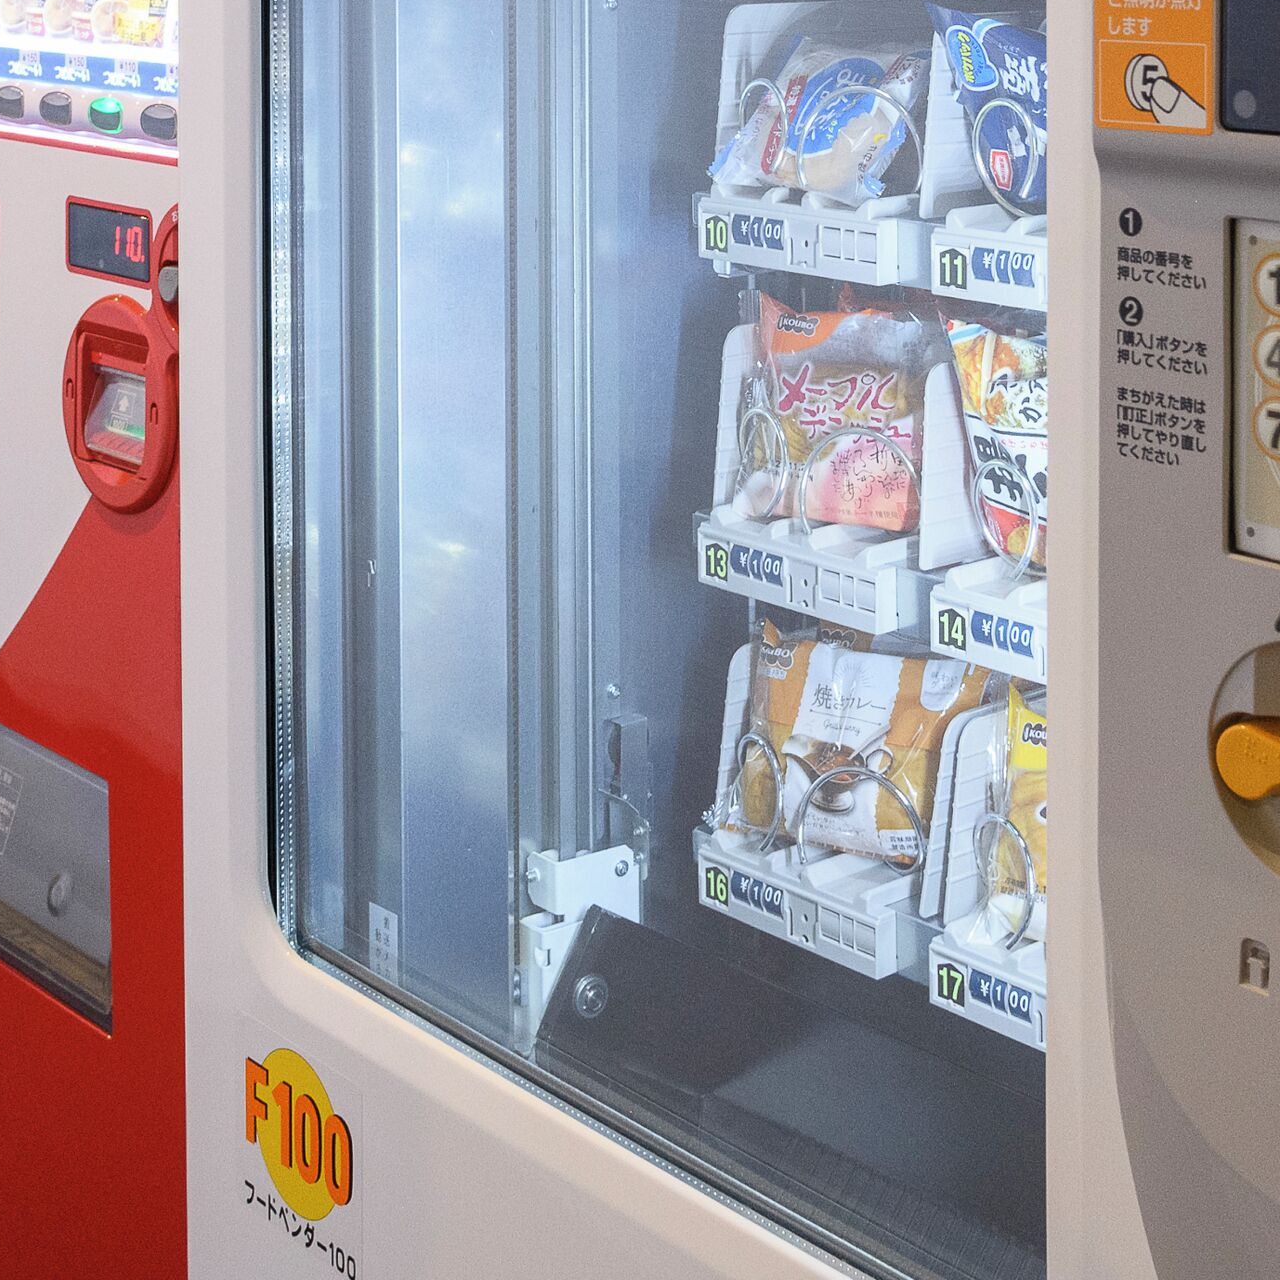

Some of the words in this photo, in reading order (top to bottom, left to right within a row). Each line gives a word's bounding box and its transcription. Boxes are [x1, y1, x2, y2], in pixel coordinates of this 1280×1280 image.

[1108, 16, 1152, 36] します
[706, 220, 727, 249] 10
[941, 253, 966, 285] 11
[1117, 247, 1193, 270] 商品の番号を
[1117, 266, 1207, 289] 押してください
[781, 316, 816, 331] KOUBO
[1117, 329, 1207, 357] 「購入」ボタンを
[1117, 349, 1208, 375] 押してください
[778, 364, 896, 412] メープル
[1117, 387, 1206, 414] まちがえた時は
[1117, 405, 1206, 434] 「訂正」ボタンを
[1117, 423, 1207, 453] 押してやり直し
[1117, 442, 1180, 465] てください
[707, 547, 727, 577] 13
[939, 612, 964, 645] 14
[810, 684, 887, 712] 焼きカレー
[706, 870, 727, 902] 16
[938, 967, 963, 1001] 17
[245, 1056, 353, 1206] F100
[245, 1179, 357, 1280] フードベンダー100
